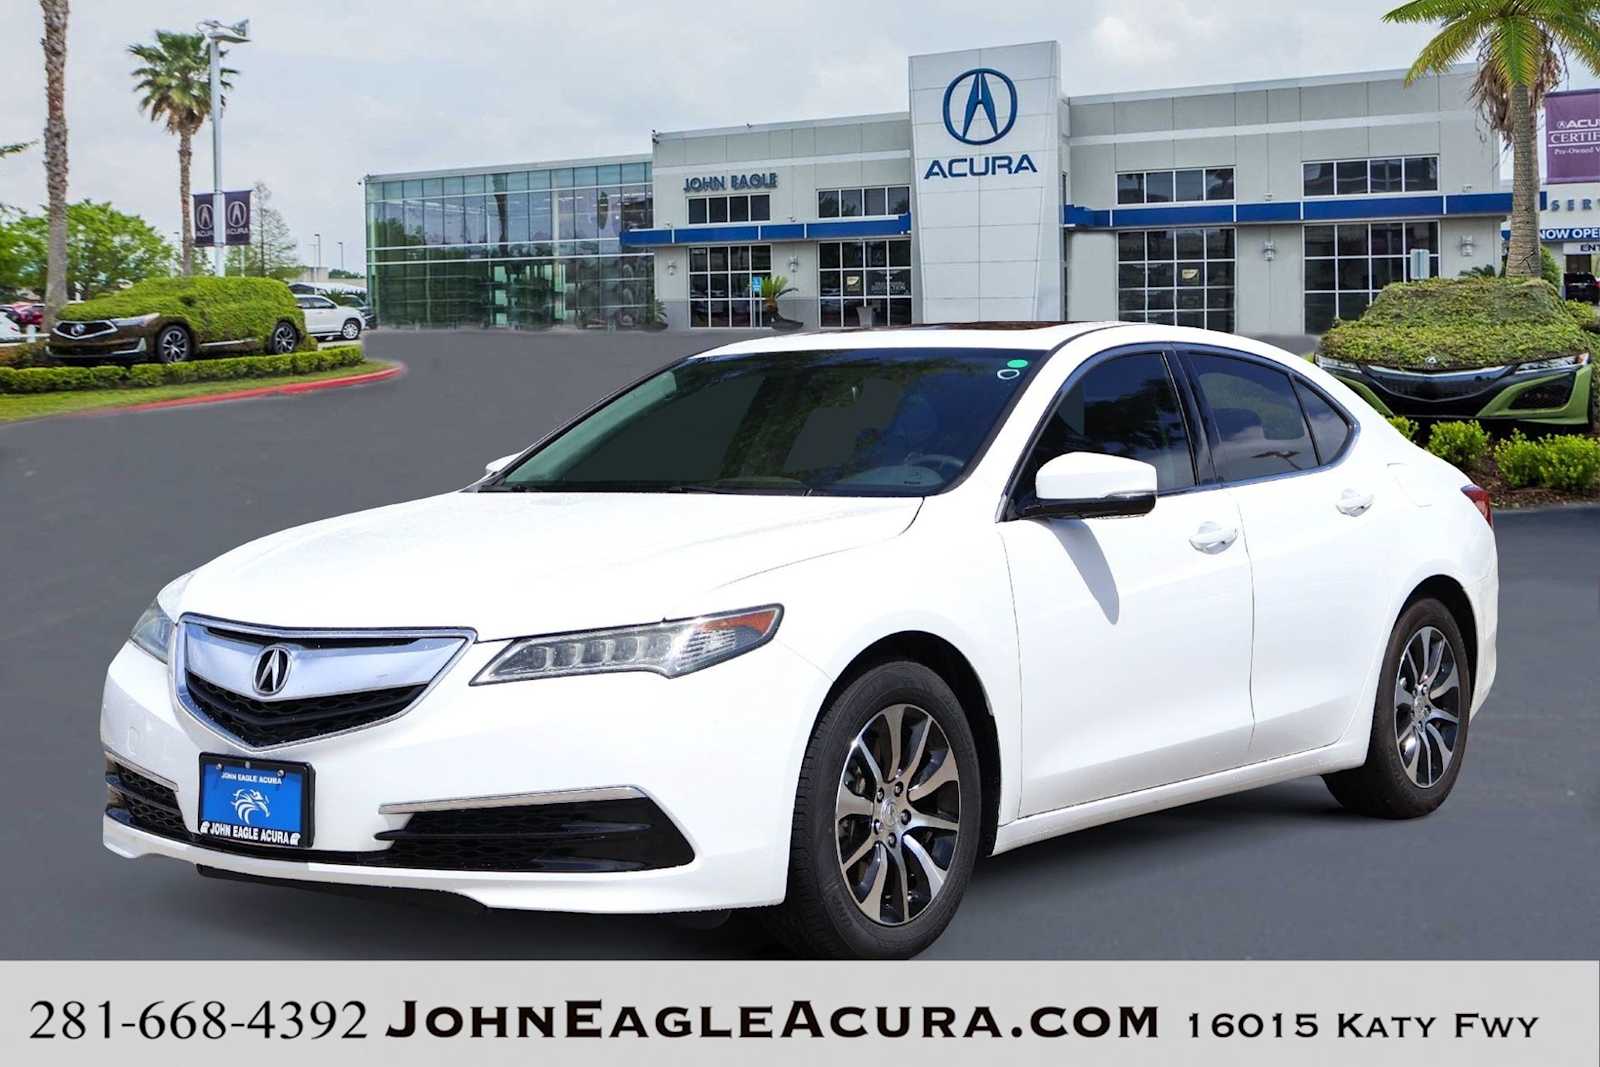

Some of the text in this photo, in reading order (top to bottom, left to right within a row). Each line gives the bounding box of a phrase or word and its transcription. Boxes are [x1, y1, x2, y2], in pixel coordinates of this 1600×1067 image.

[1567, 119, 1600, 129] ACU
[923, 153, 1039, 180] ACURA
[683, 172, 778, 192] JOHN EAGLE
[1540, 228, 1600, 239] NOW OPE
[221, 772, 282, 784] JOHN EAGLE ACURA
[210, 822, 289, 845] JOHN EAGLE ACURA
